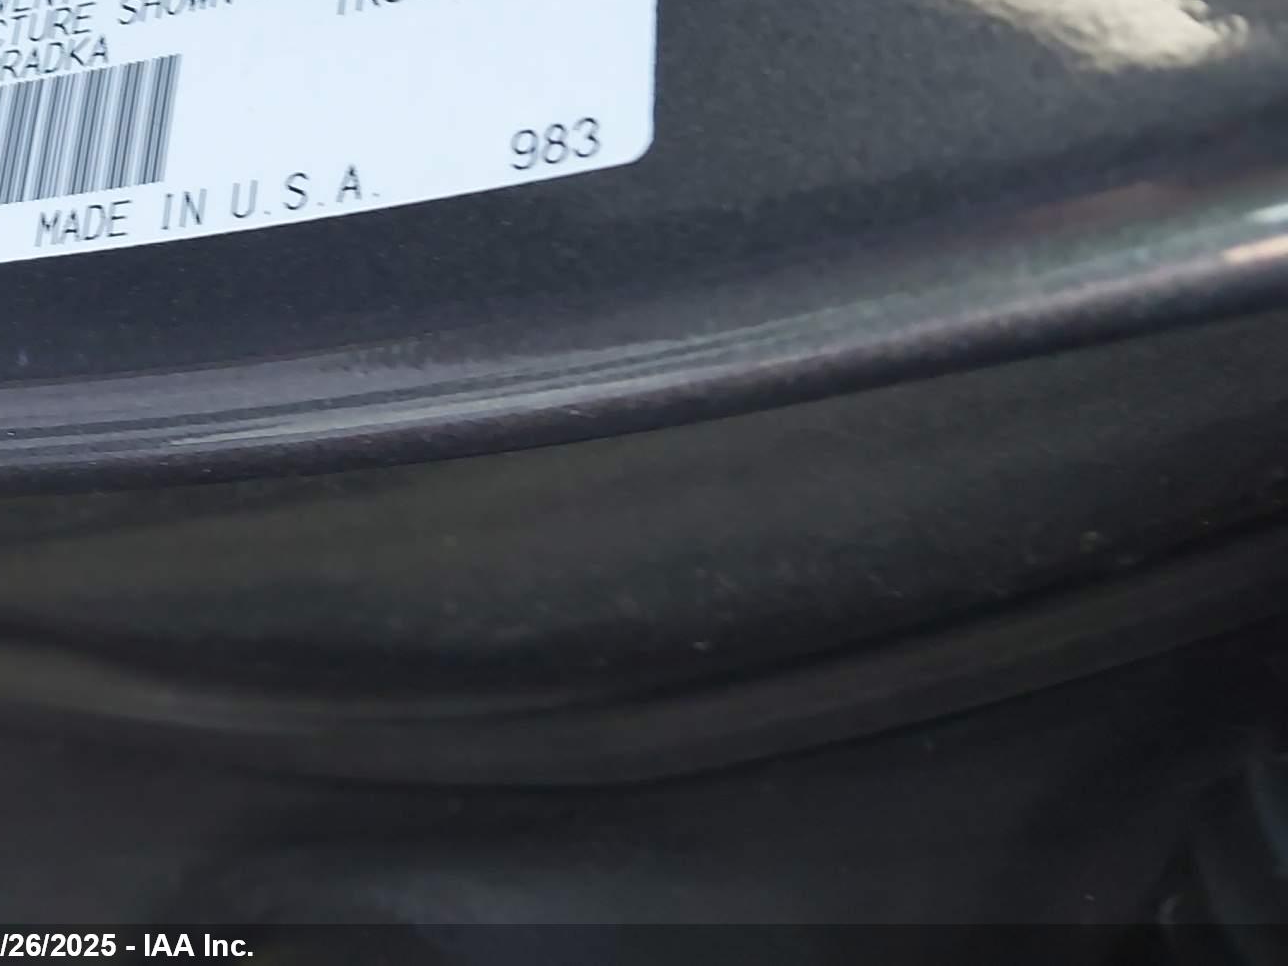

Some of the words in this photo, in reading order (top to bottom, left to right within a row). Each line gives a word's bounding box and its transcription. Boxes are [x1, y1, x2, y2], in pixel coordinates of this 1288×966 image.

[510, 116, 601, 171] 983
[33, 199, 133, 248] MADE
[160, 187, 208, 231] IN
[230, 164, 382, 221] U.S.A.
